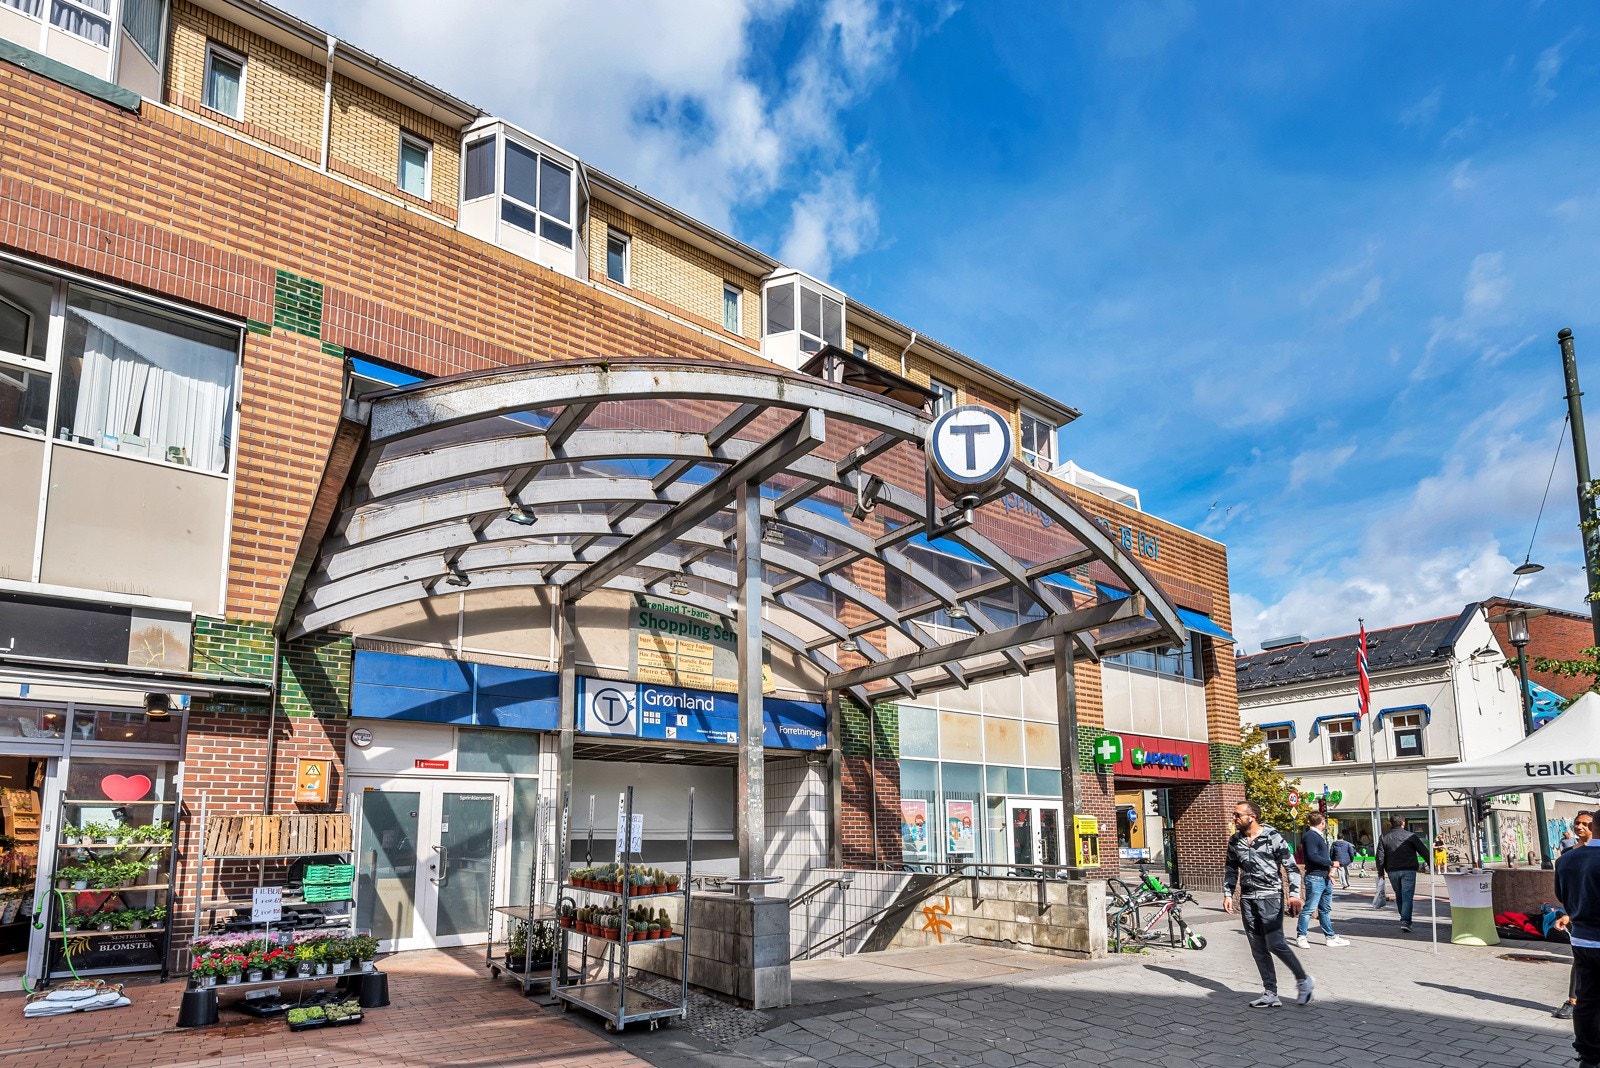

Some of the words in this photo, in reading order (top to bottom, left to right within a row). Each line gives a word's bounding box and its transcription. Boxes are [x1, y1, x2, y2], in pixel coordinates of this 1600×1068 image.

[950, 424, 990, 470] T
[1137, 529, 1159, 561] (16)
[640, 599, 679, 613] Grønland
[681, 605, 709, 619] T-bane
[639, 612, 710, 641] Shopping
[713, 624, 738, 643] Sen
[640, 667, 659, 675] Metro
[602, 696, 620, 721] T
[644, 689, 714, 712] Grønland
[780, 725, 822, 738] Forretninger
[1144, 751, 1184, 767] APOTEK
